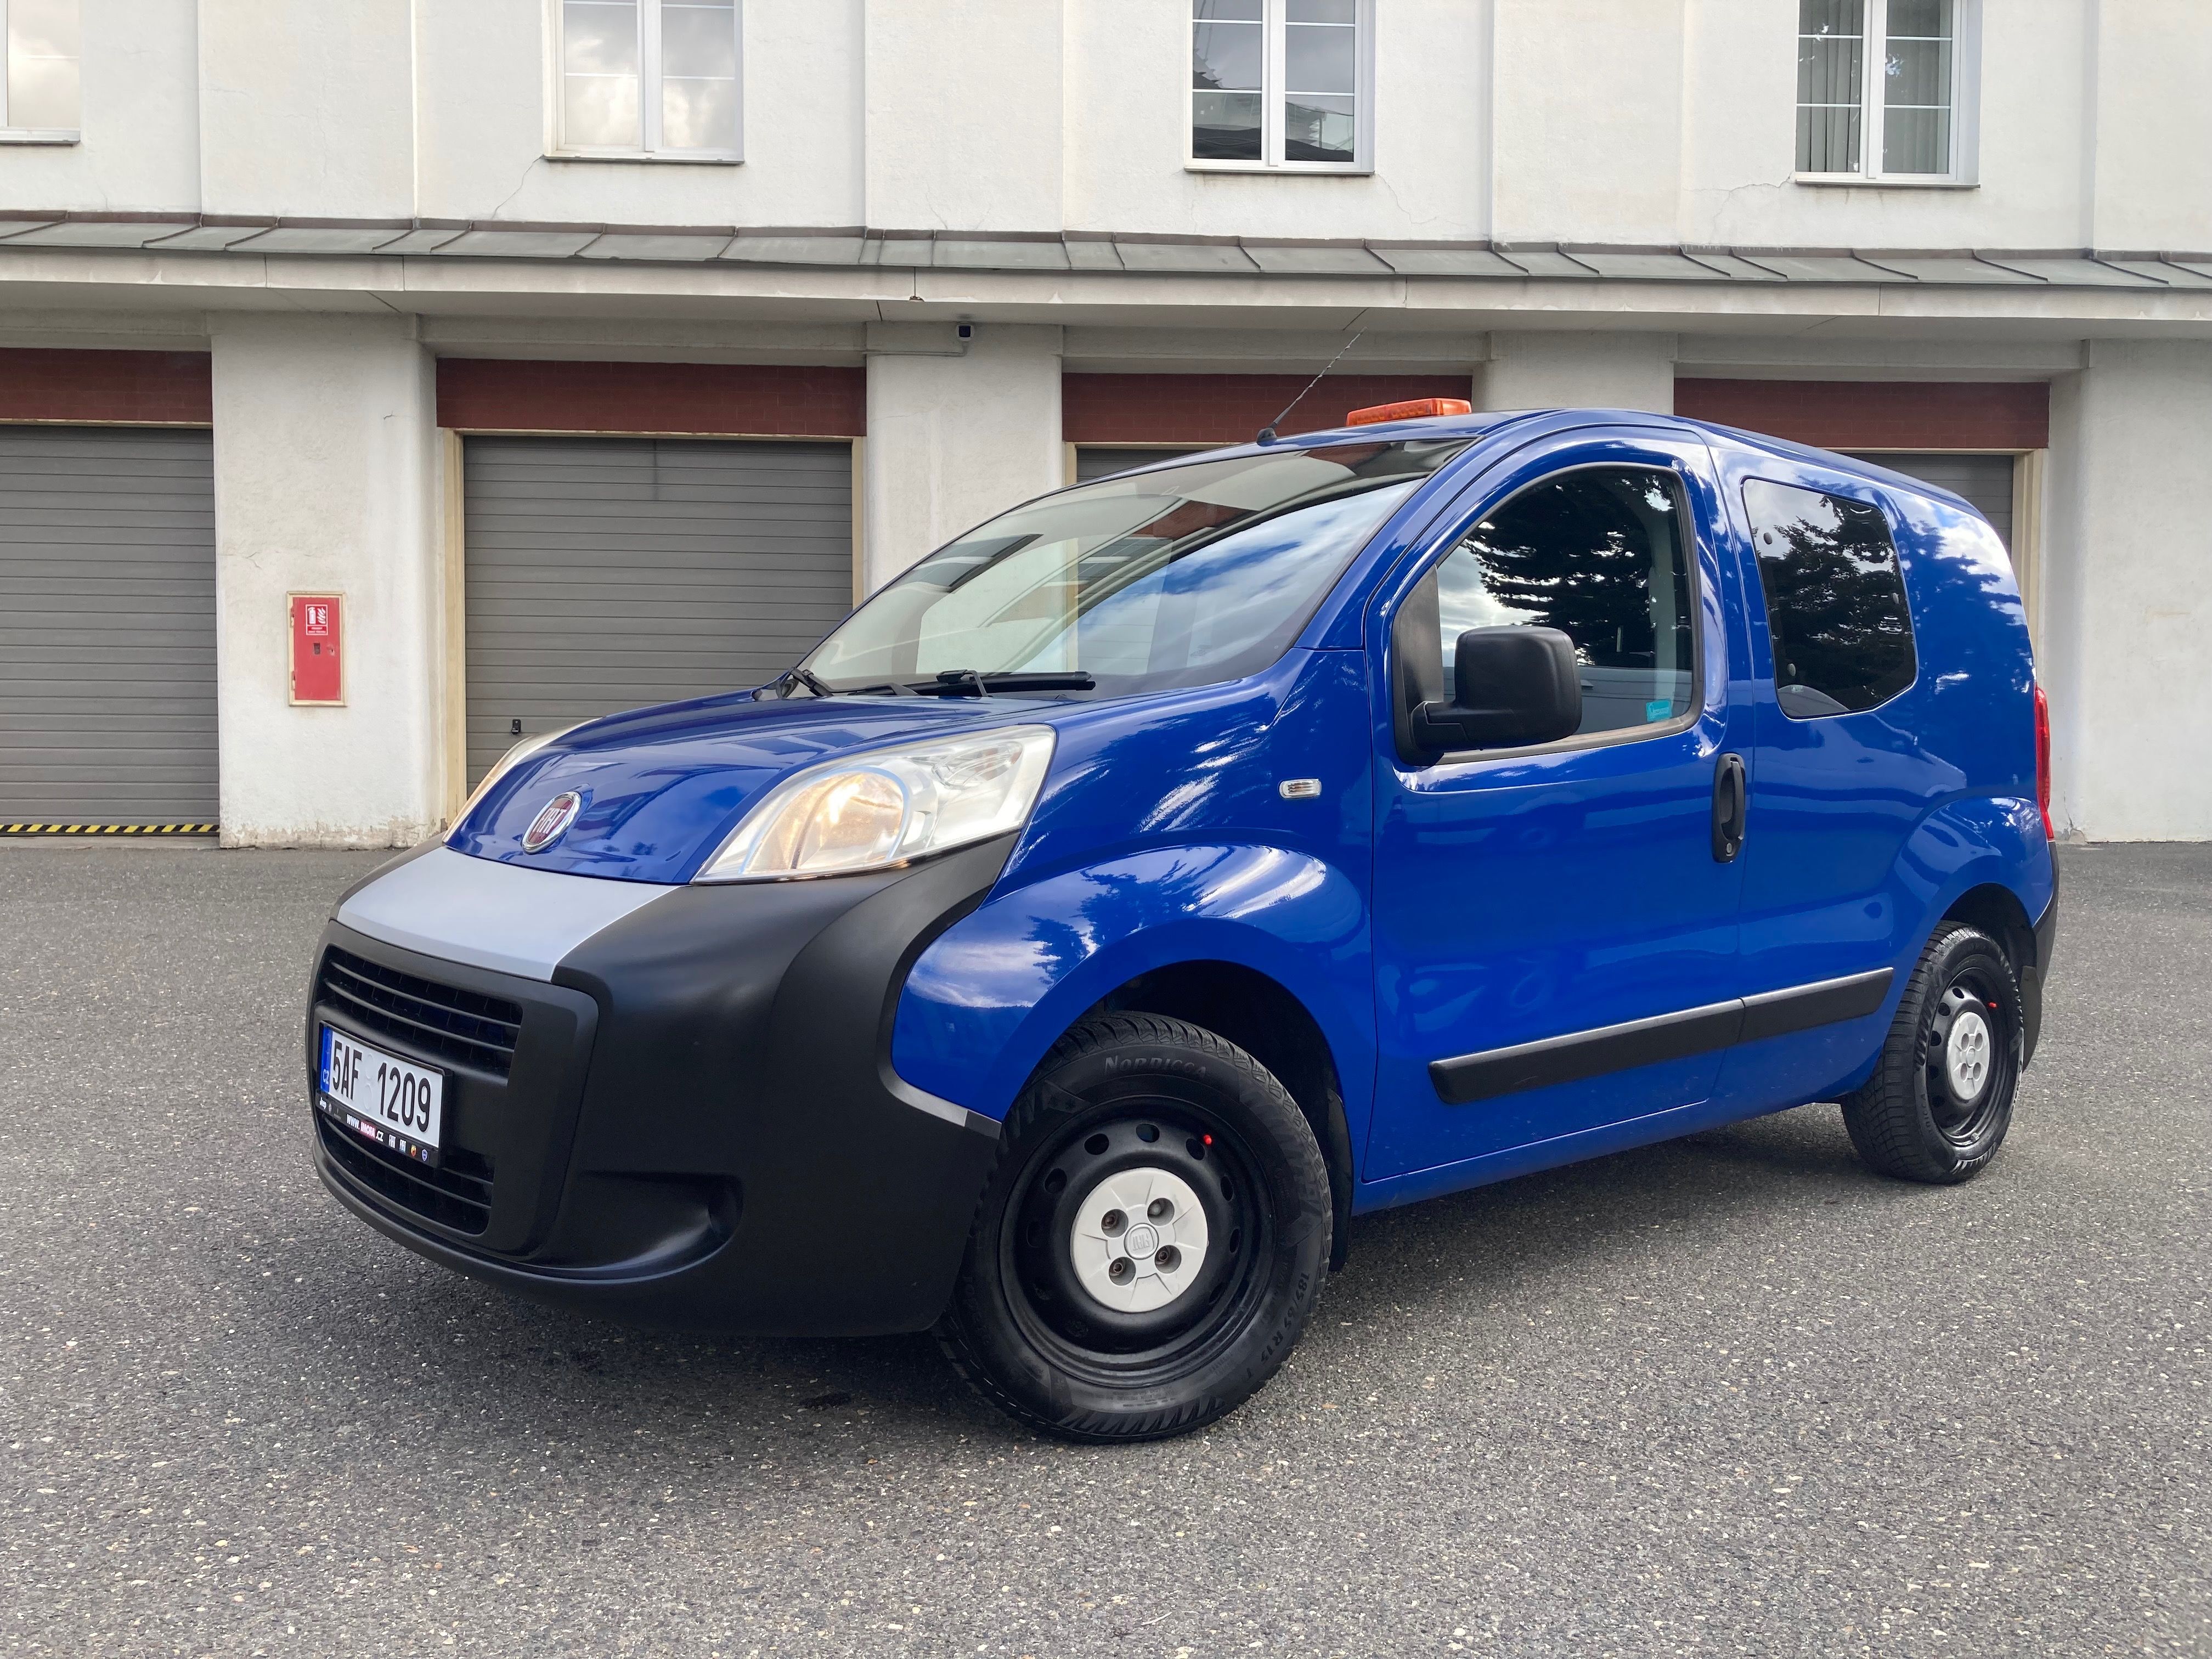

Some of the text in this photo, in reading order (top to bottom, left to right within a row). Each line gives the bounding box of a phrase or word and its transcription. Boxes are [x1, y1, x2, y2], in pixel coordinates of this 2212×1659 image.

[532, 807, 567, 834] FIAT
[323, 1068, 329, 1085] CZ
[332, 1040, 431, 1133] 5AF 1209
